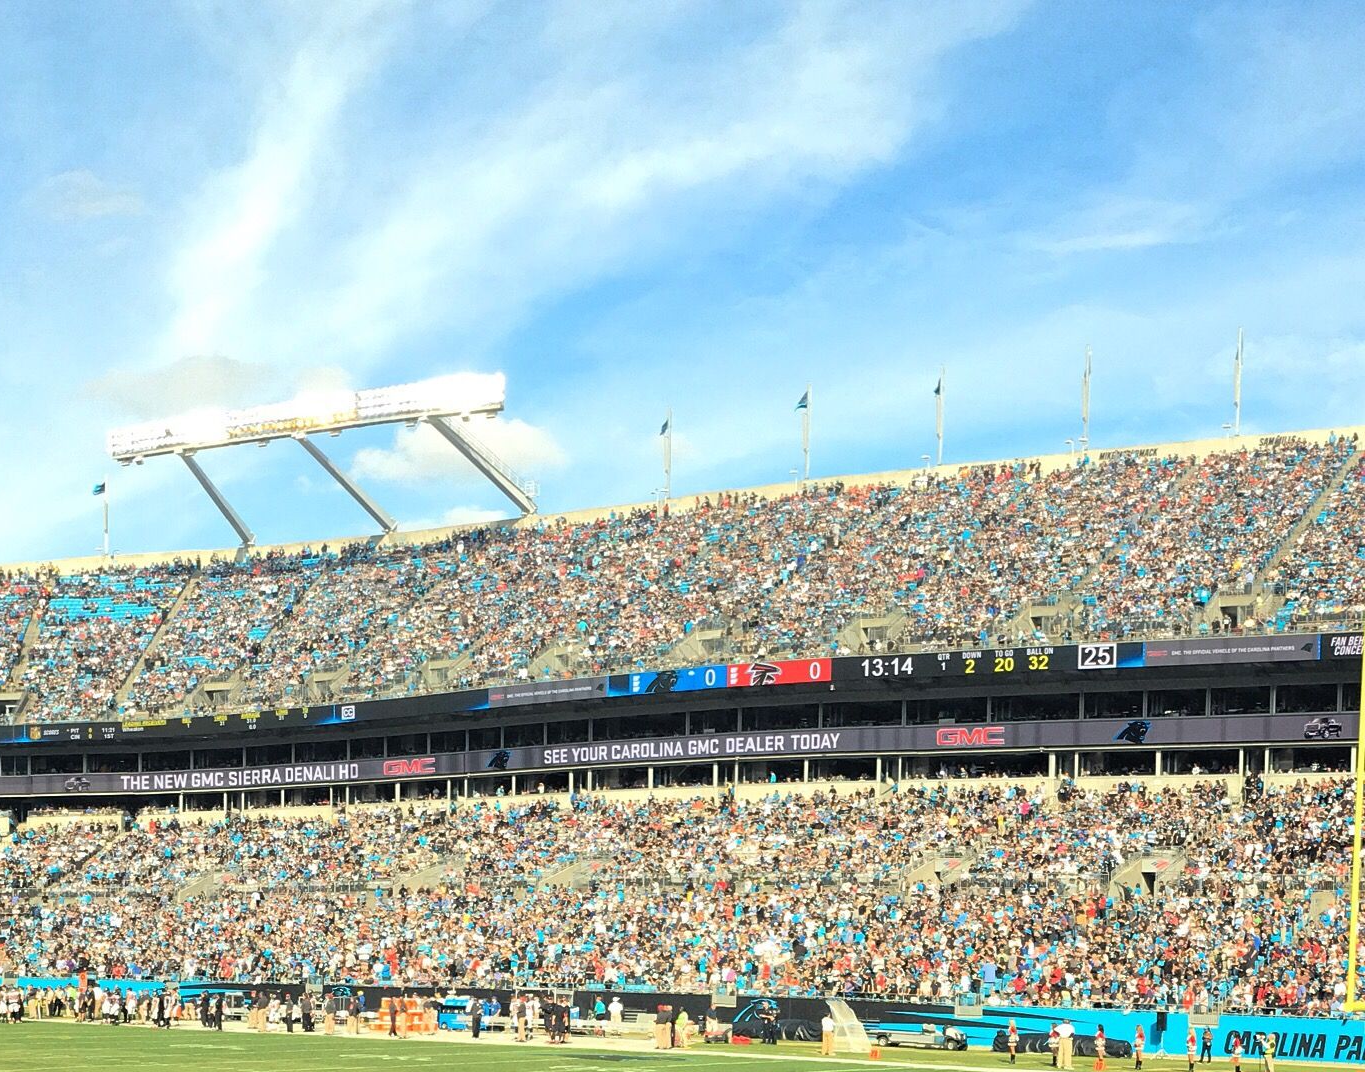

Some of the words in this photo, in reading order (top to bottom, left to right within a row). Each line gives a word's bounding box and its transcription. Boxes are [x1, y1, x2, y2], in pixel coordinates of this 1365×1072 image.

[1330, 636, 1346, 646] FAN
[937, 653, 950, 661] QTR
[962, 651, 982, 659] DOWN
[995, 650, 1003, 658] TO
[1004, 649, 1014, 657] GO
[1026, 648, 1042, 656] BALL
[1044, 647, 1054, 655] ON
[1083, 646, 1112, 666] 25
[809, 661, 821, 680] 0
[861, 657, 914, 678] 13:14
[940, 662, 946, 671] 1
[965, 660, 975, 674] 2
[994, 657, 1014, 672] 20
[1028, 655, 1049, 671] 32
[704, 669, 716, 687] 0
[936, 726, 1005, 746] GMC
[544, 749, 568, 764] SEE
[572, 746, 608, 762] YOUR
[611, 741, 684, 760] CAROLINA
[688, 738, 720, 755] GMC
[725, 735, 785, 753] DEALER
[791, 733, 841, 750] TODAY
[383, 757, 436, 776] GMC
[121, 775, 150, 791] THE
[153, 773, 187, 790] NEW
[190, 771, 224, 788] GMC
[228, 768, 282, 786] SIERRA
[285, 765, 335, 783] DENALI
[338, 763, 359, 780] HD
[1224, 1029, 1326, 1060] CARLINA
